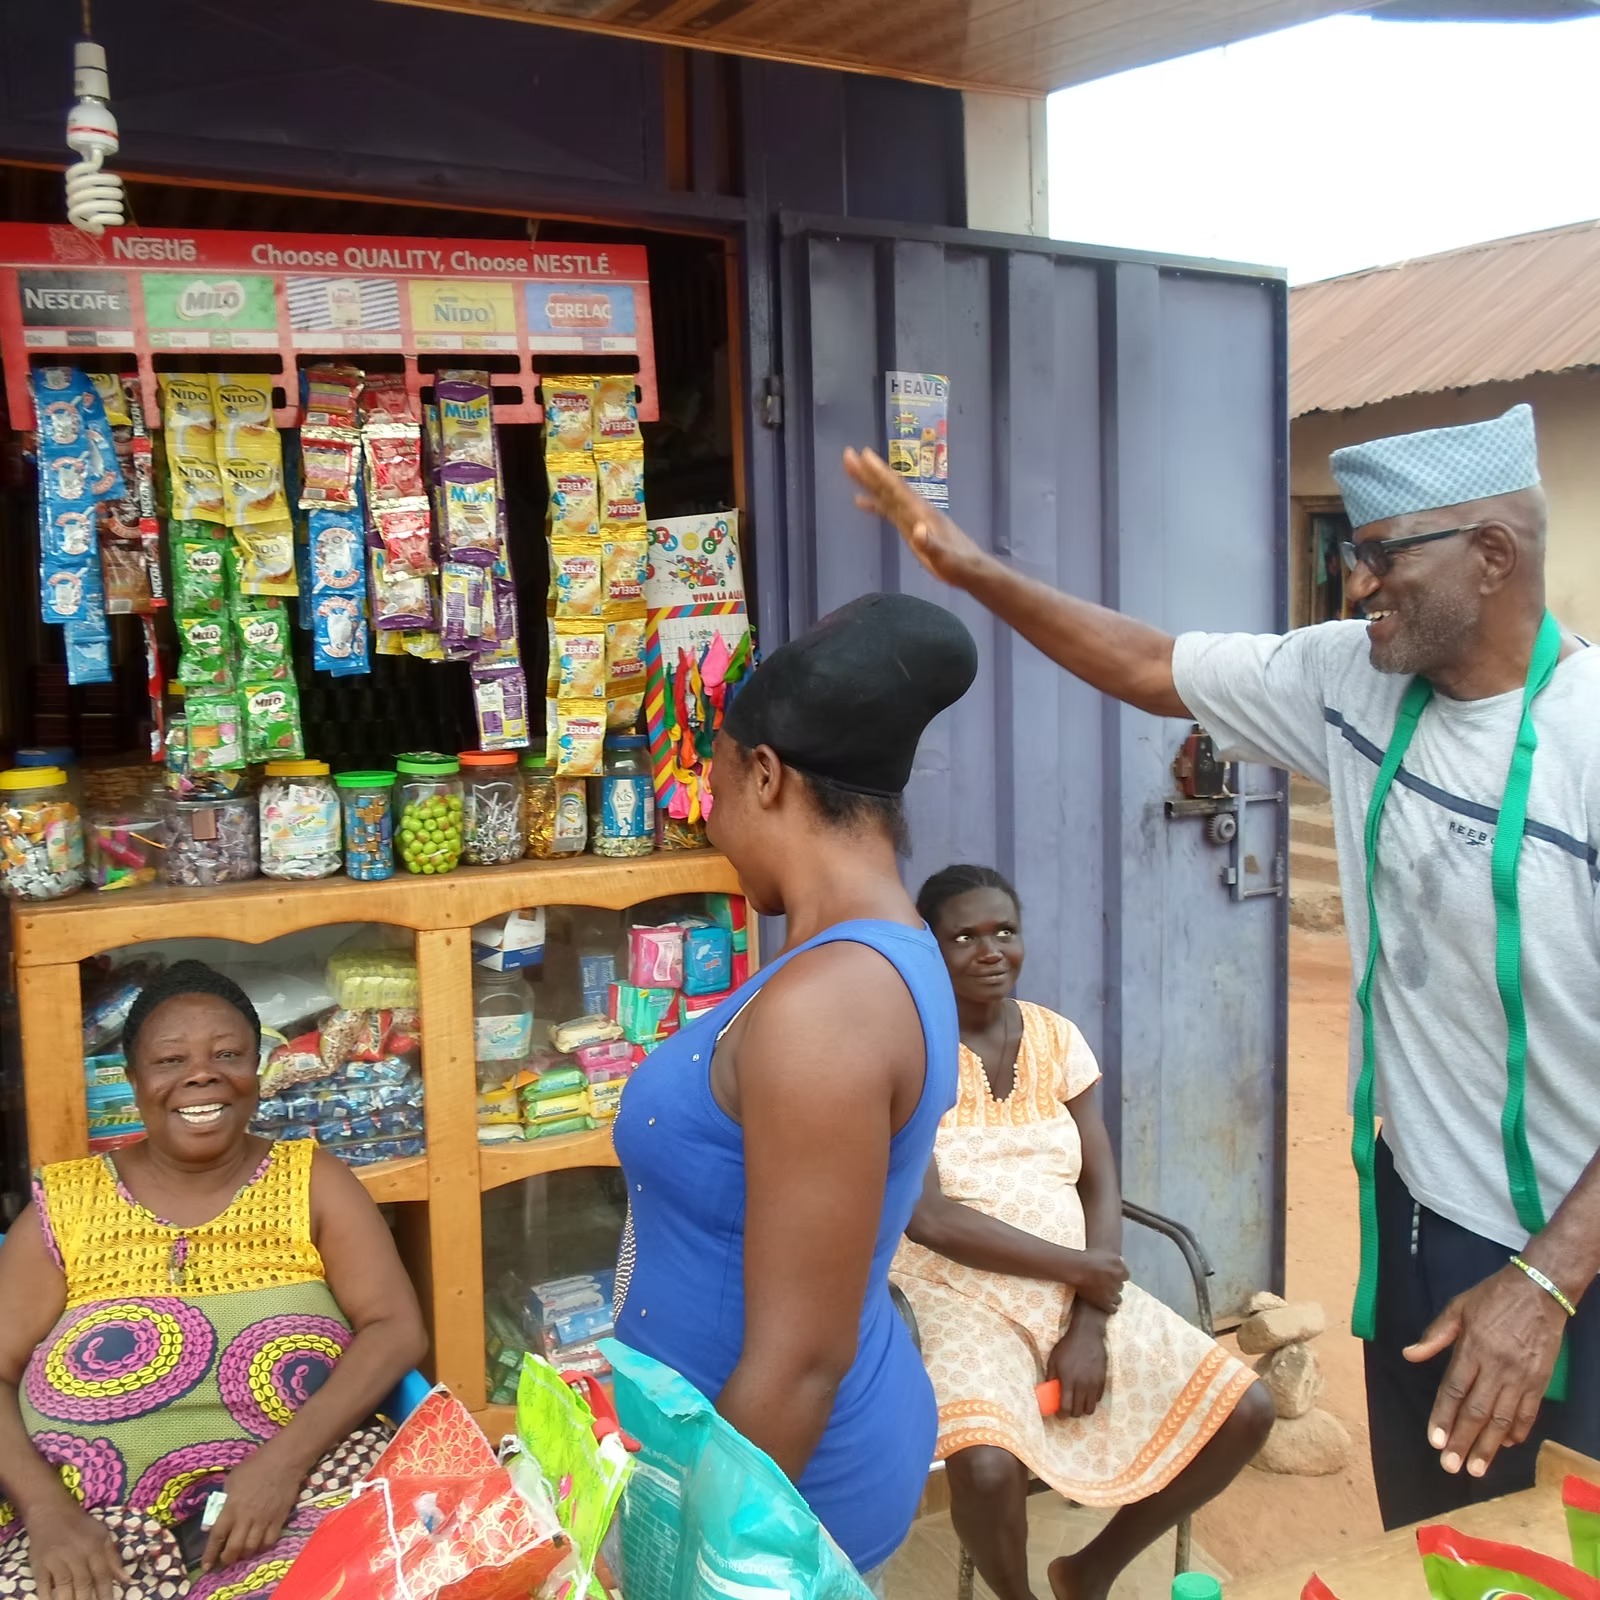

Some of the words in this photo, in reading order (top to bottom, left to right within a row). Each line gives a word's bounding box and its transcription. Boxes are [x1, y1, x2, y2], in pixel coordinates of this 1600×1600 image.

[251, 244, 339, 266] Choose
[343, 247, 445, 272] QUALITY,
[451, 250, 528, 272] Choose
[533, 253, 610, 275] NESTLÉ
[186, 292, 240, 311] MILO
[434, 304, 489, 322] NIDO
[545, 303, 612, 319] CERELAC
[170, 387, 208, 401] NIDO
[220, 394, 259, 403] NIDO
[444, 402, 488, 419] Miksi
[178, 466, 215, 479] NIDO
[226, 468, 265, 479] NIDO
[557, 482, 594, 491] CERELAC
[451, 486, 493, 503] Miksi
[255, 697, 282, 708] MILO
